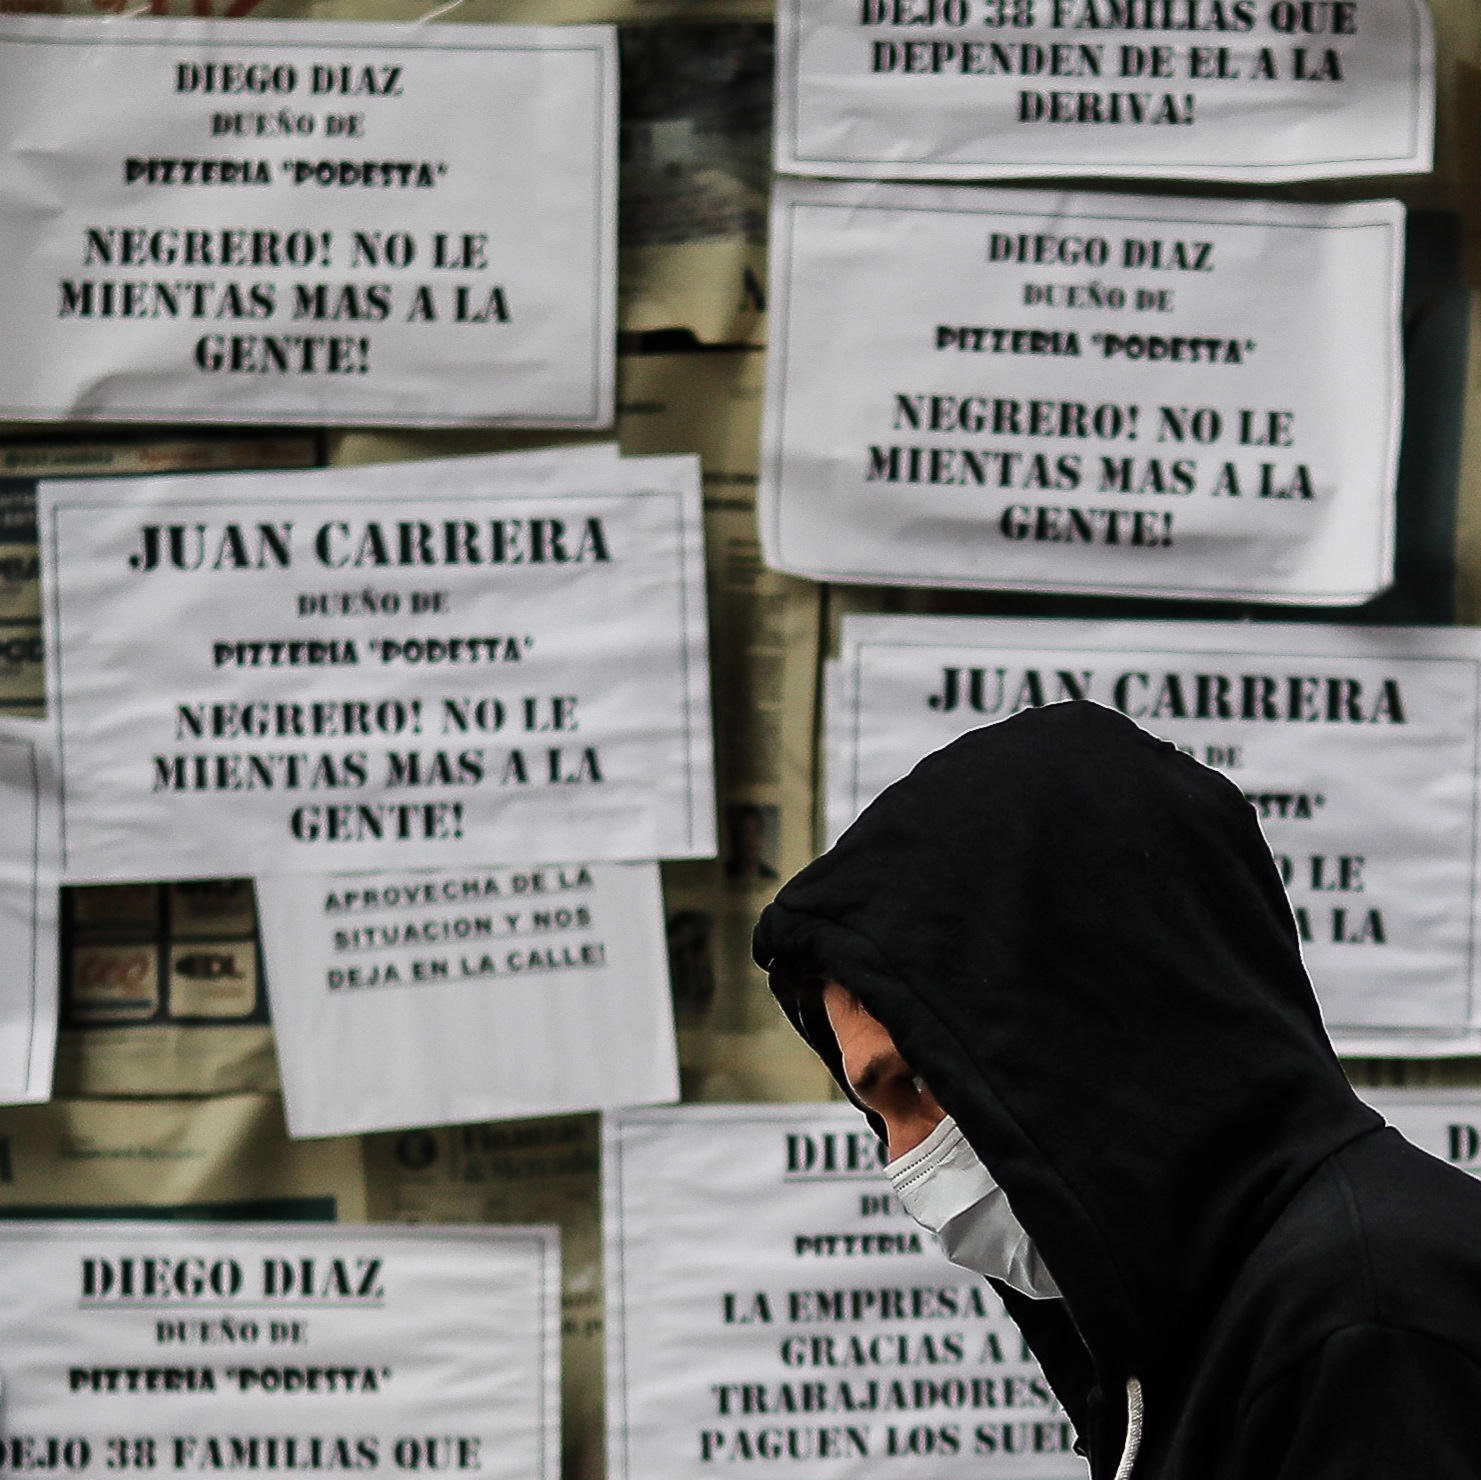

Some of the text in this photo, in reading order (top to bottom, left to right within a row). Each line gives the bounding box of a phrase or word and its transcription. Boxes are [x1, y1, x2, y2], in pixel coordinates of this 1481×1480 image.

[174, 61, 403, 96] DIEGO DIAZ
[870, 39, 1350, 84] DEPENDEN DE EL A LA
[83, 227, 488, 270] NEGRERO! NO LE
[894, 393, 1294, 447] NEGRERO! NO LE
[127, 516, 612, 572] JUAN CARRERA
[152, 746, 604, 792] MIENTAS MAS A LA
[81, 1257, 384, 1298] DIEGO DIAZ
